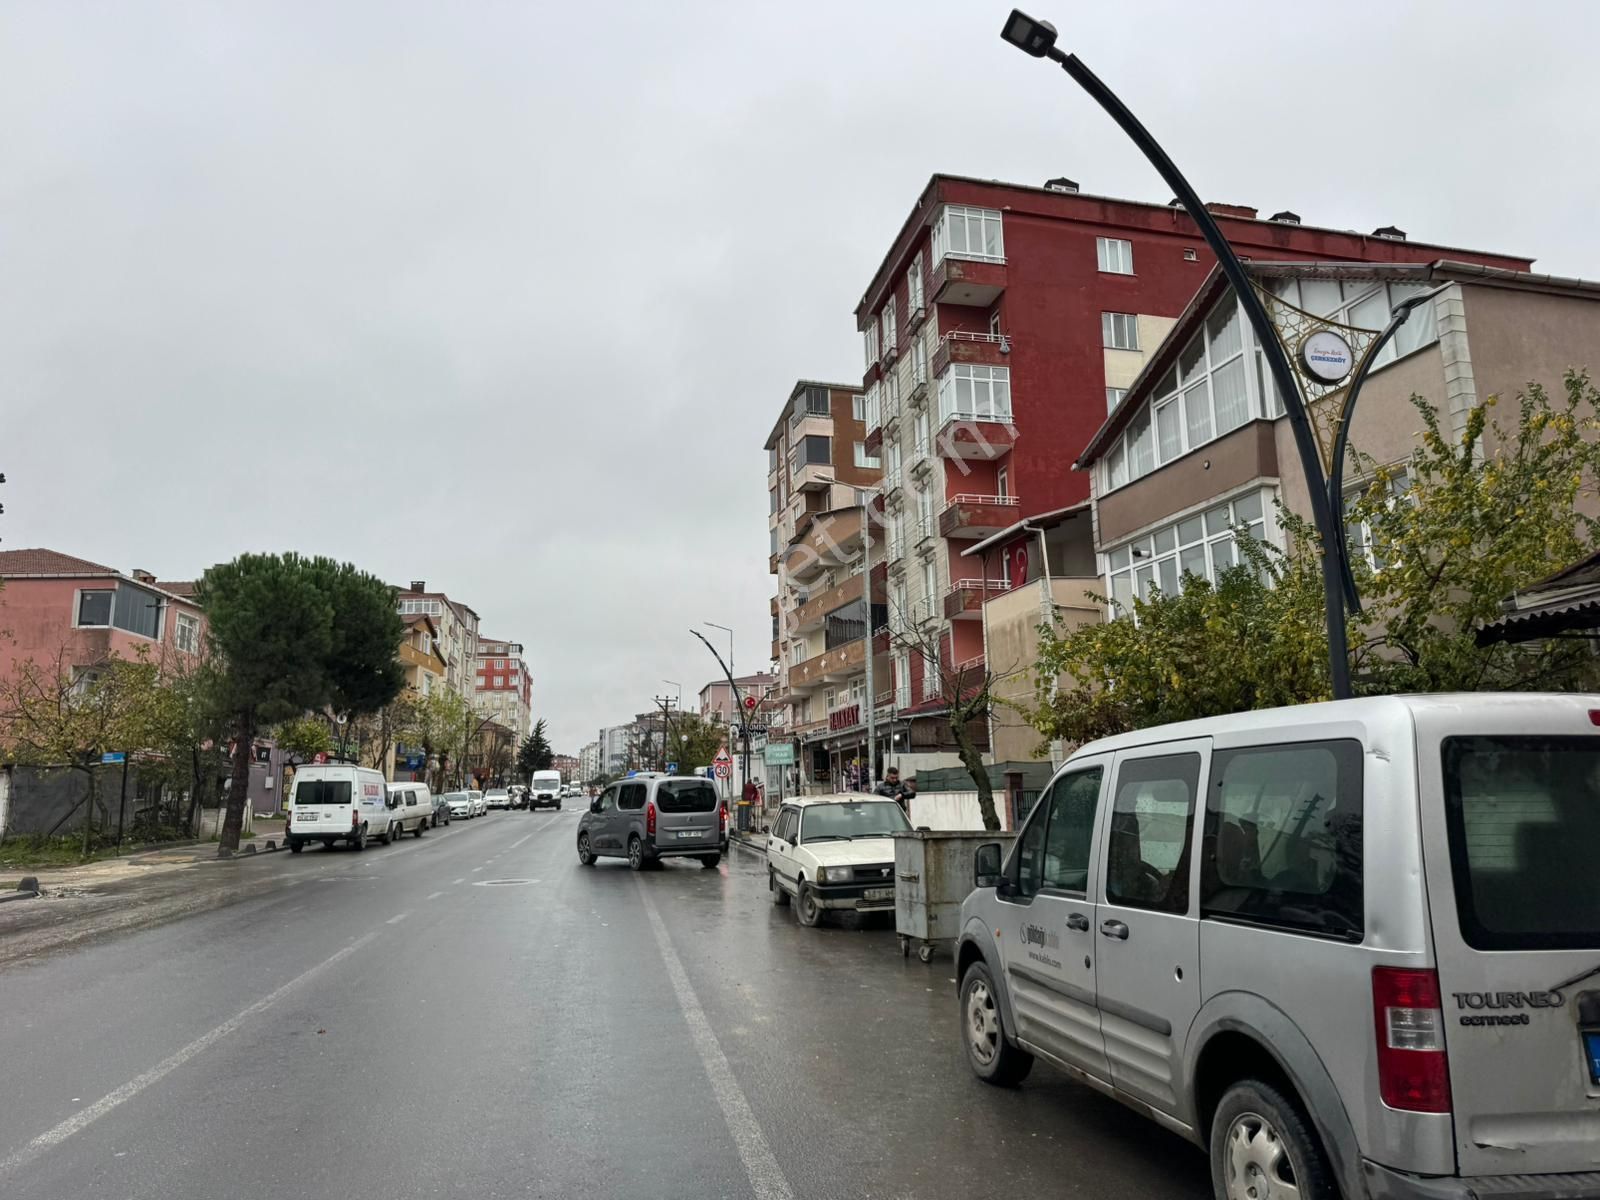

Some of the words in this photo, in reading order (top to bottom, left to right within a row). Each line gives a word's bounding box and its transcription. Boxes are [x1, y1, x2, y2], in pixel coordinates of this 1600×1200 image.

[718, 766, 727, 775] 30
[1452, 991, 1566, 1009] TOURNEO
[1460, 1013, 1530, 1026] connect
